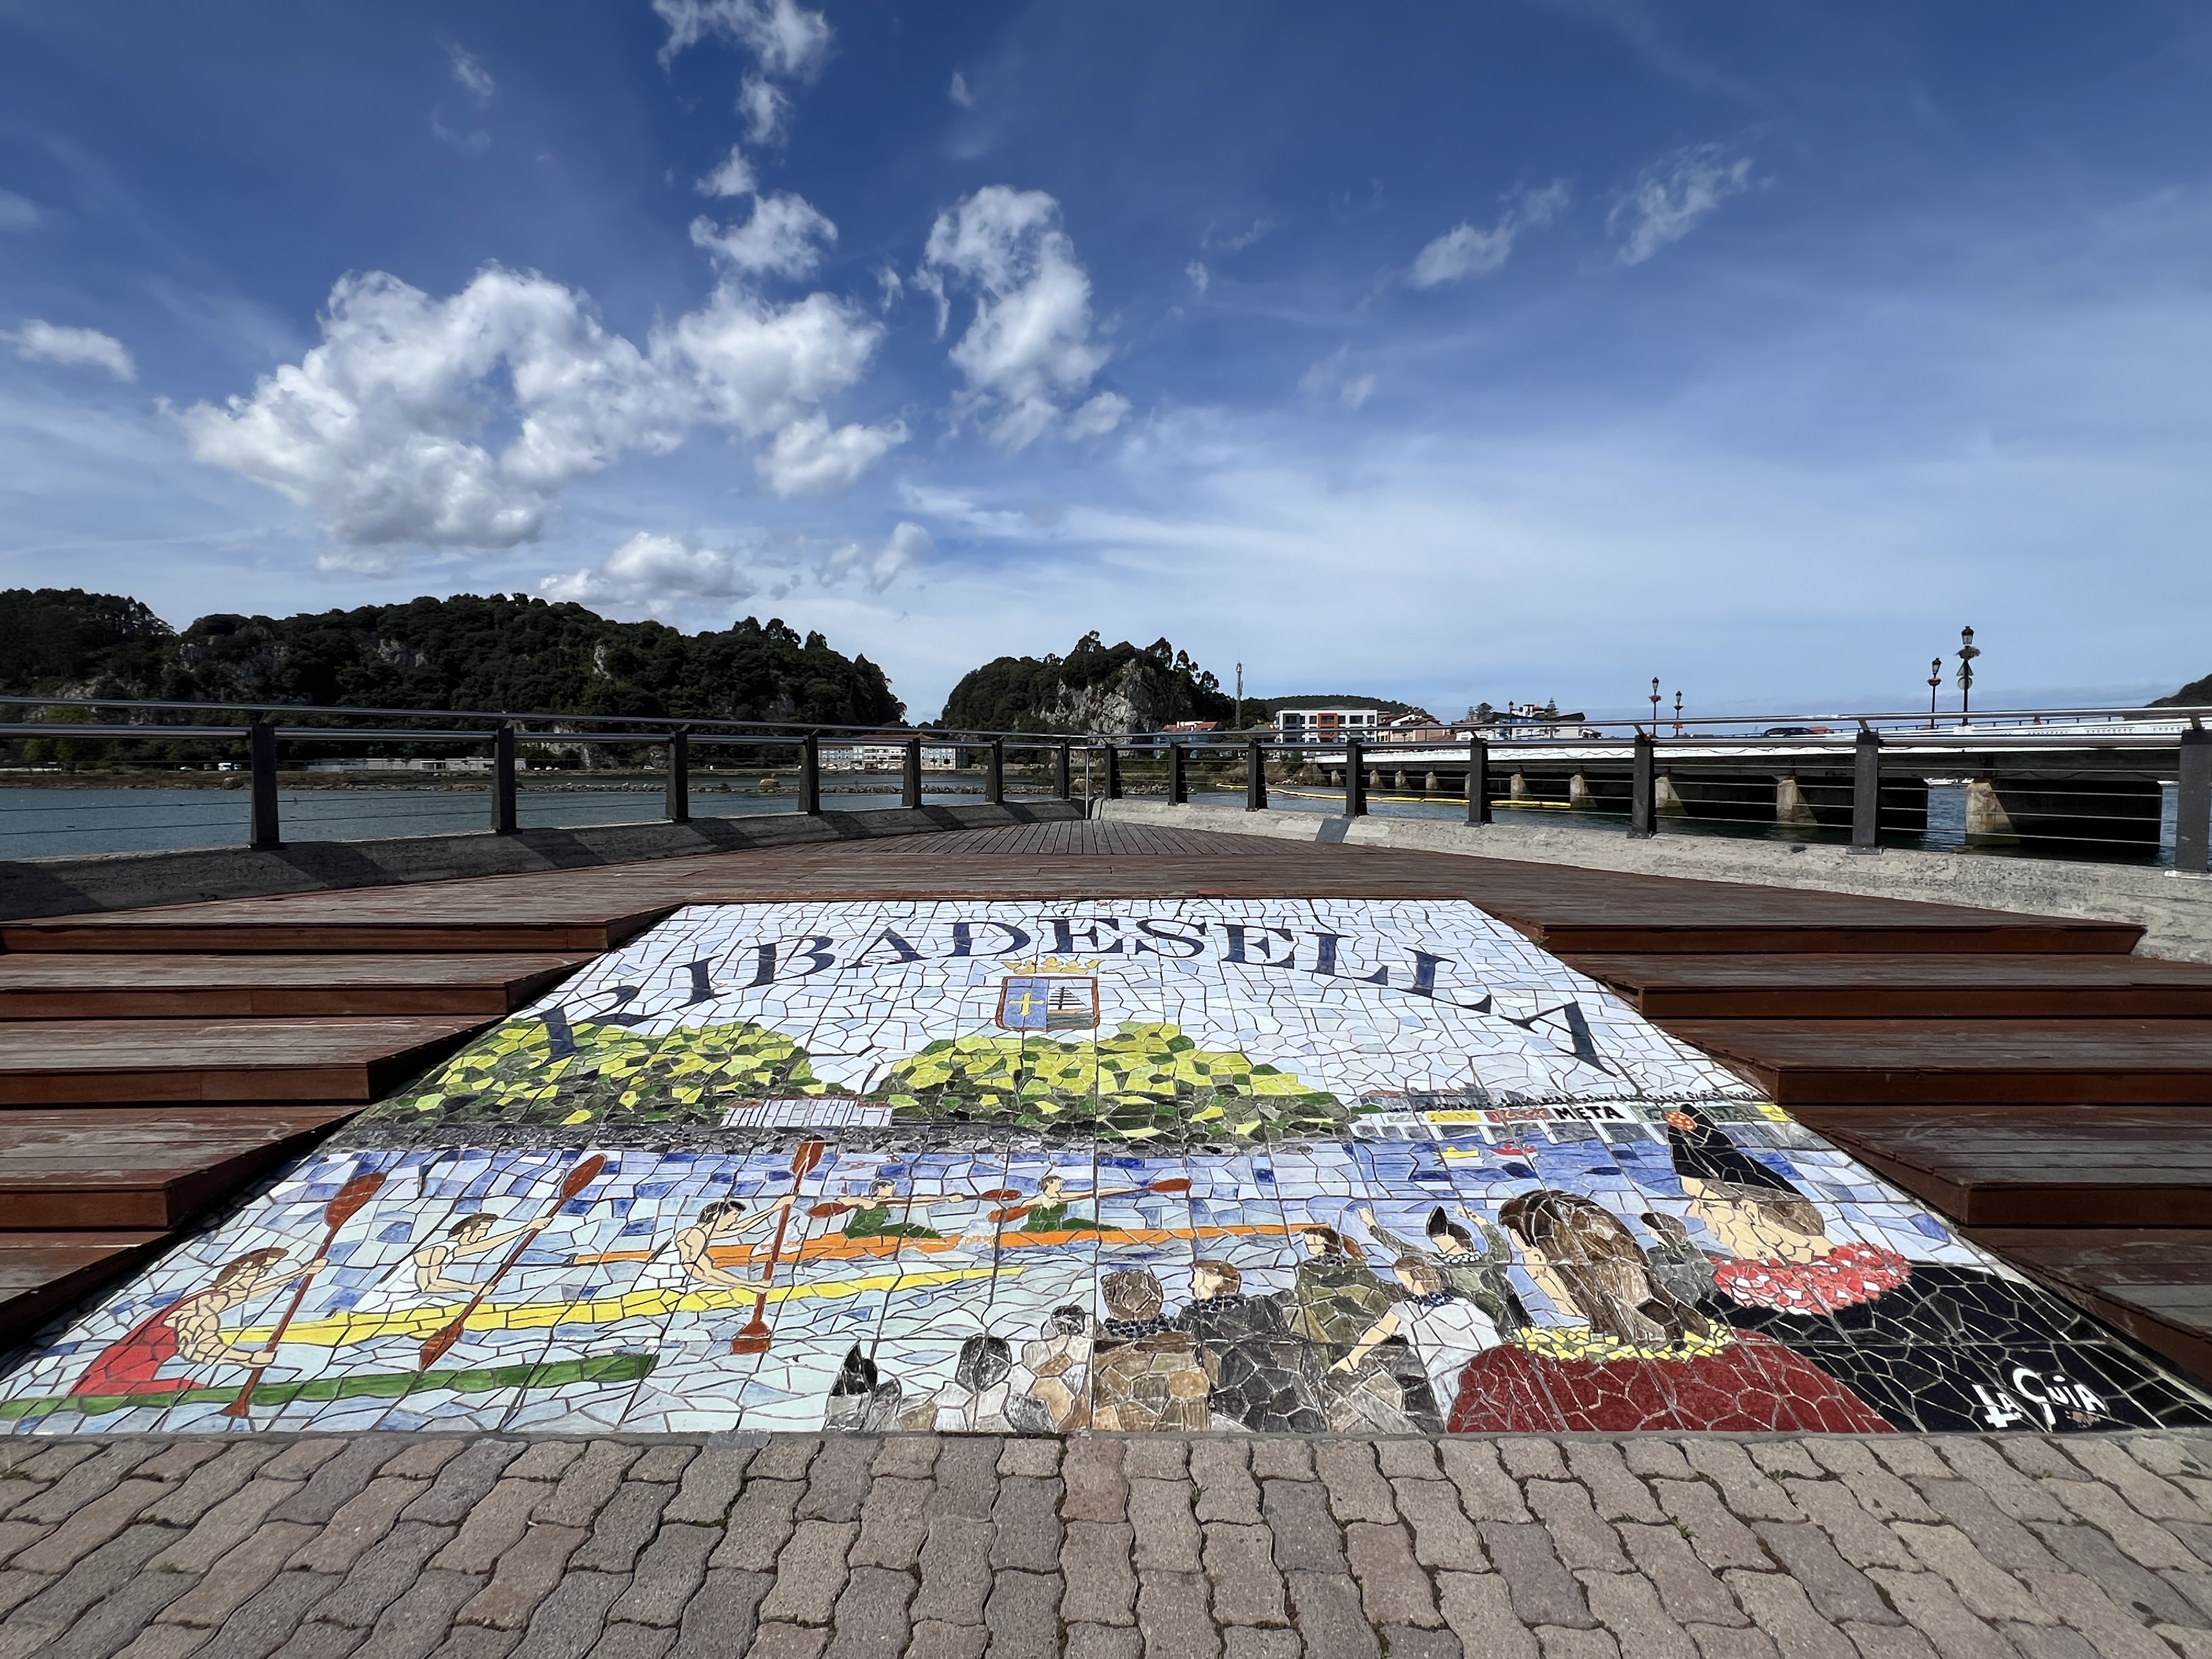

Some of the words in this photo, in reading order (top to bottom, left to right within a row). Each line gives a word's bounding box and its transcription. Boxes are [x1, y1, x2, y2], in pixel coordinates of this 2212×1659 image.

[529, 917, 1617, 1077] RIBADESELLA
[1551, 1106, 1627, 1120] META
[1971, 1384, 2023, 1429] LA
